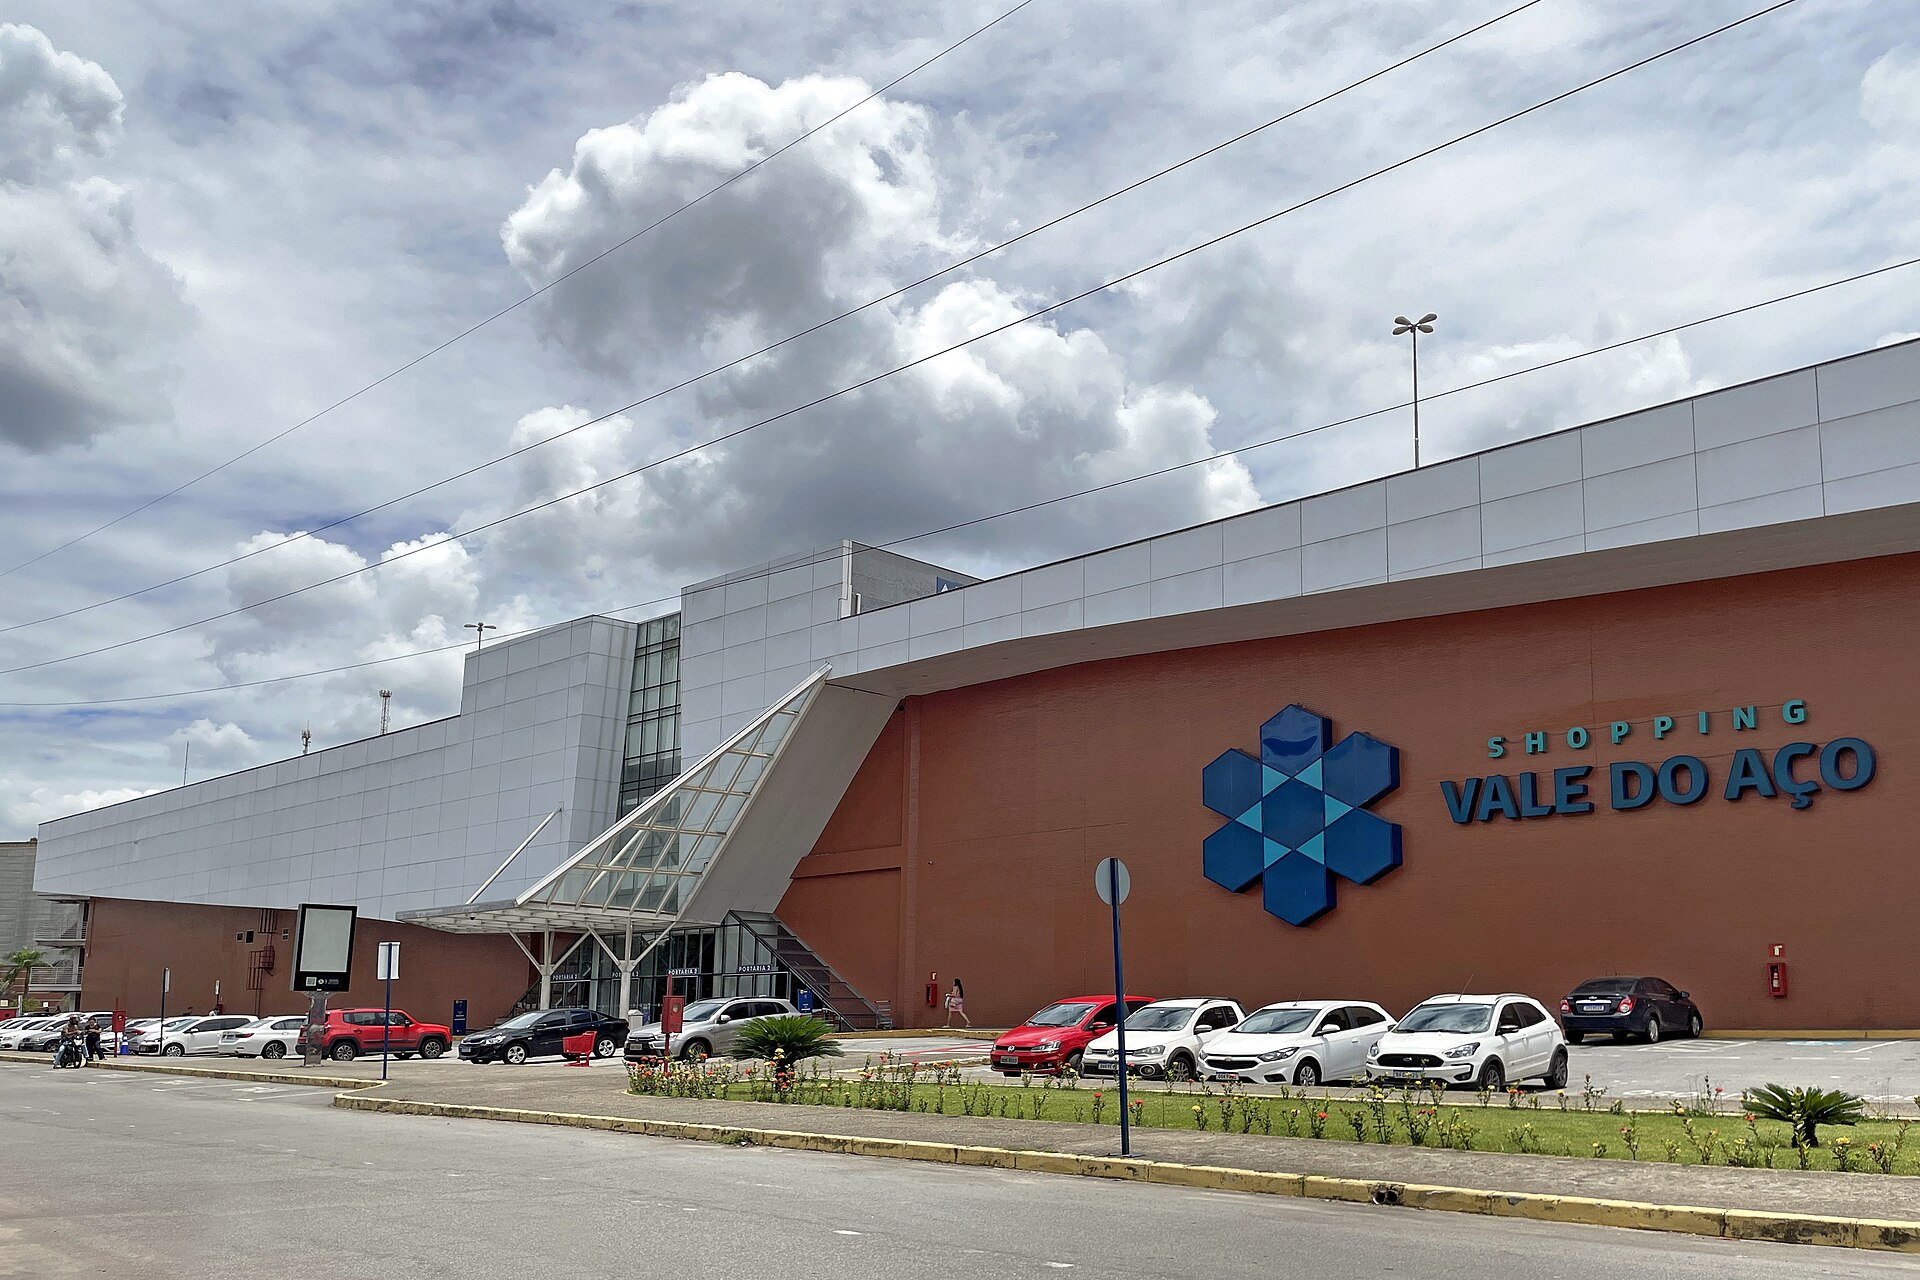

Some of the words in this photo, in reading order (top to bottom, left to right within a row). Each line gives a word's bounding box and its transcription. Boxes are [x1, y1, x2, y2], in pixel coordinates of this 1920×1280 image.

[1487, 700, 1806, 758] SHOPPING
[1440, 765, 1595, 824] VALE
[1609, 755, 1710, 811] DO
[1723, 737, 1877, 809] AÇO
